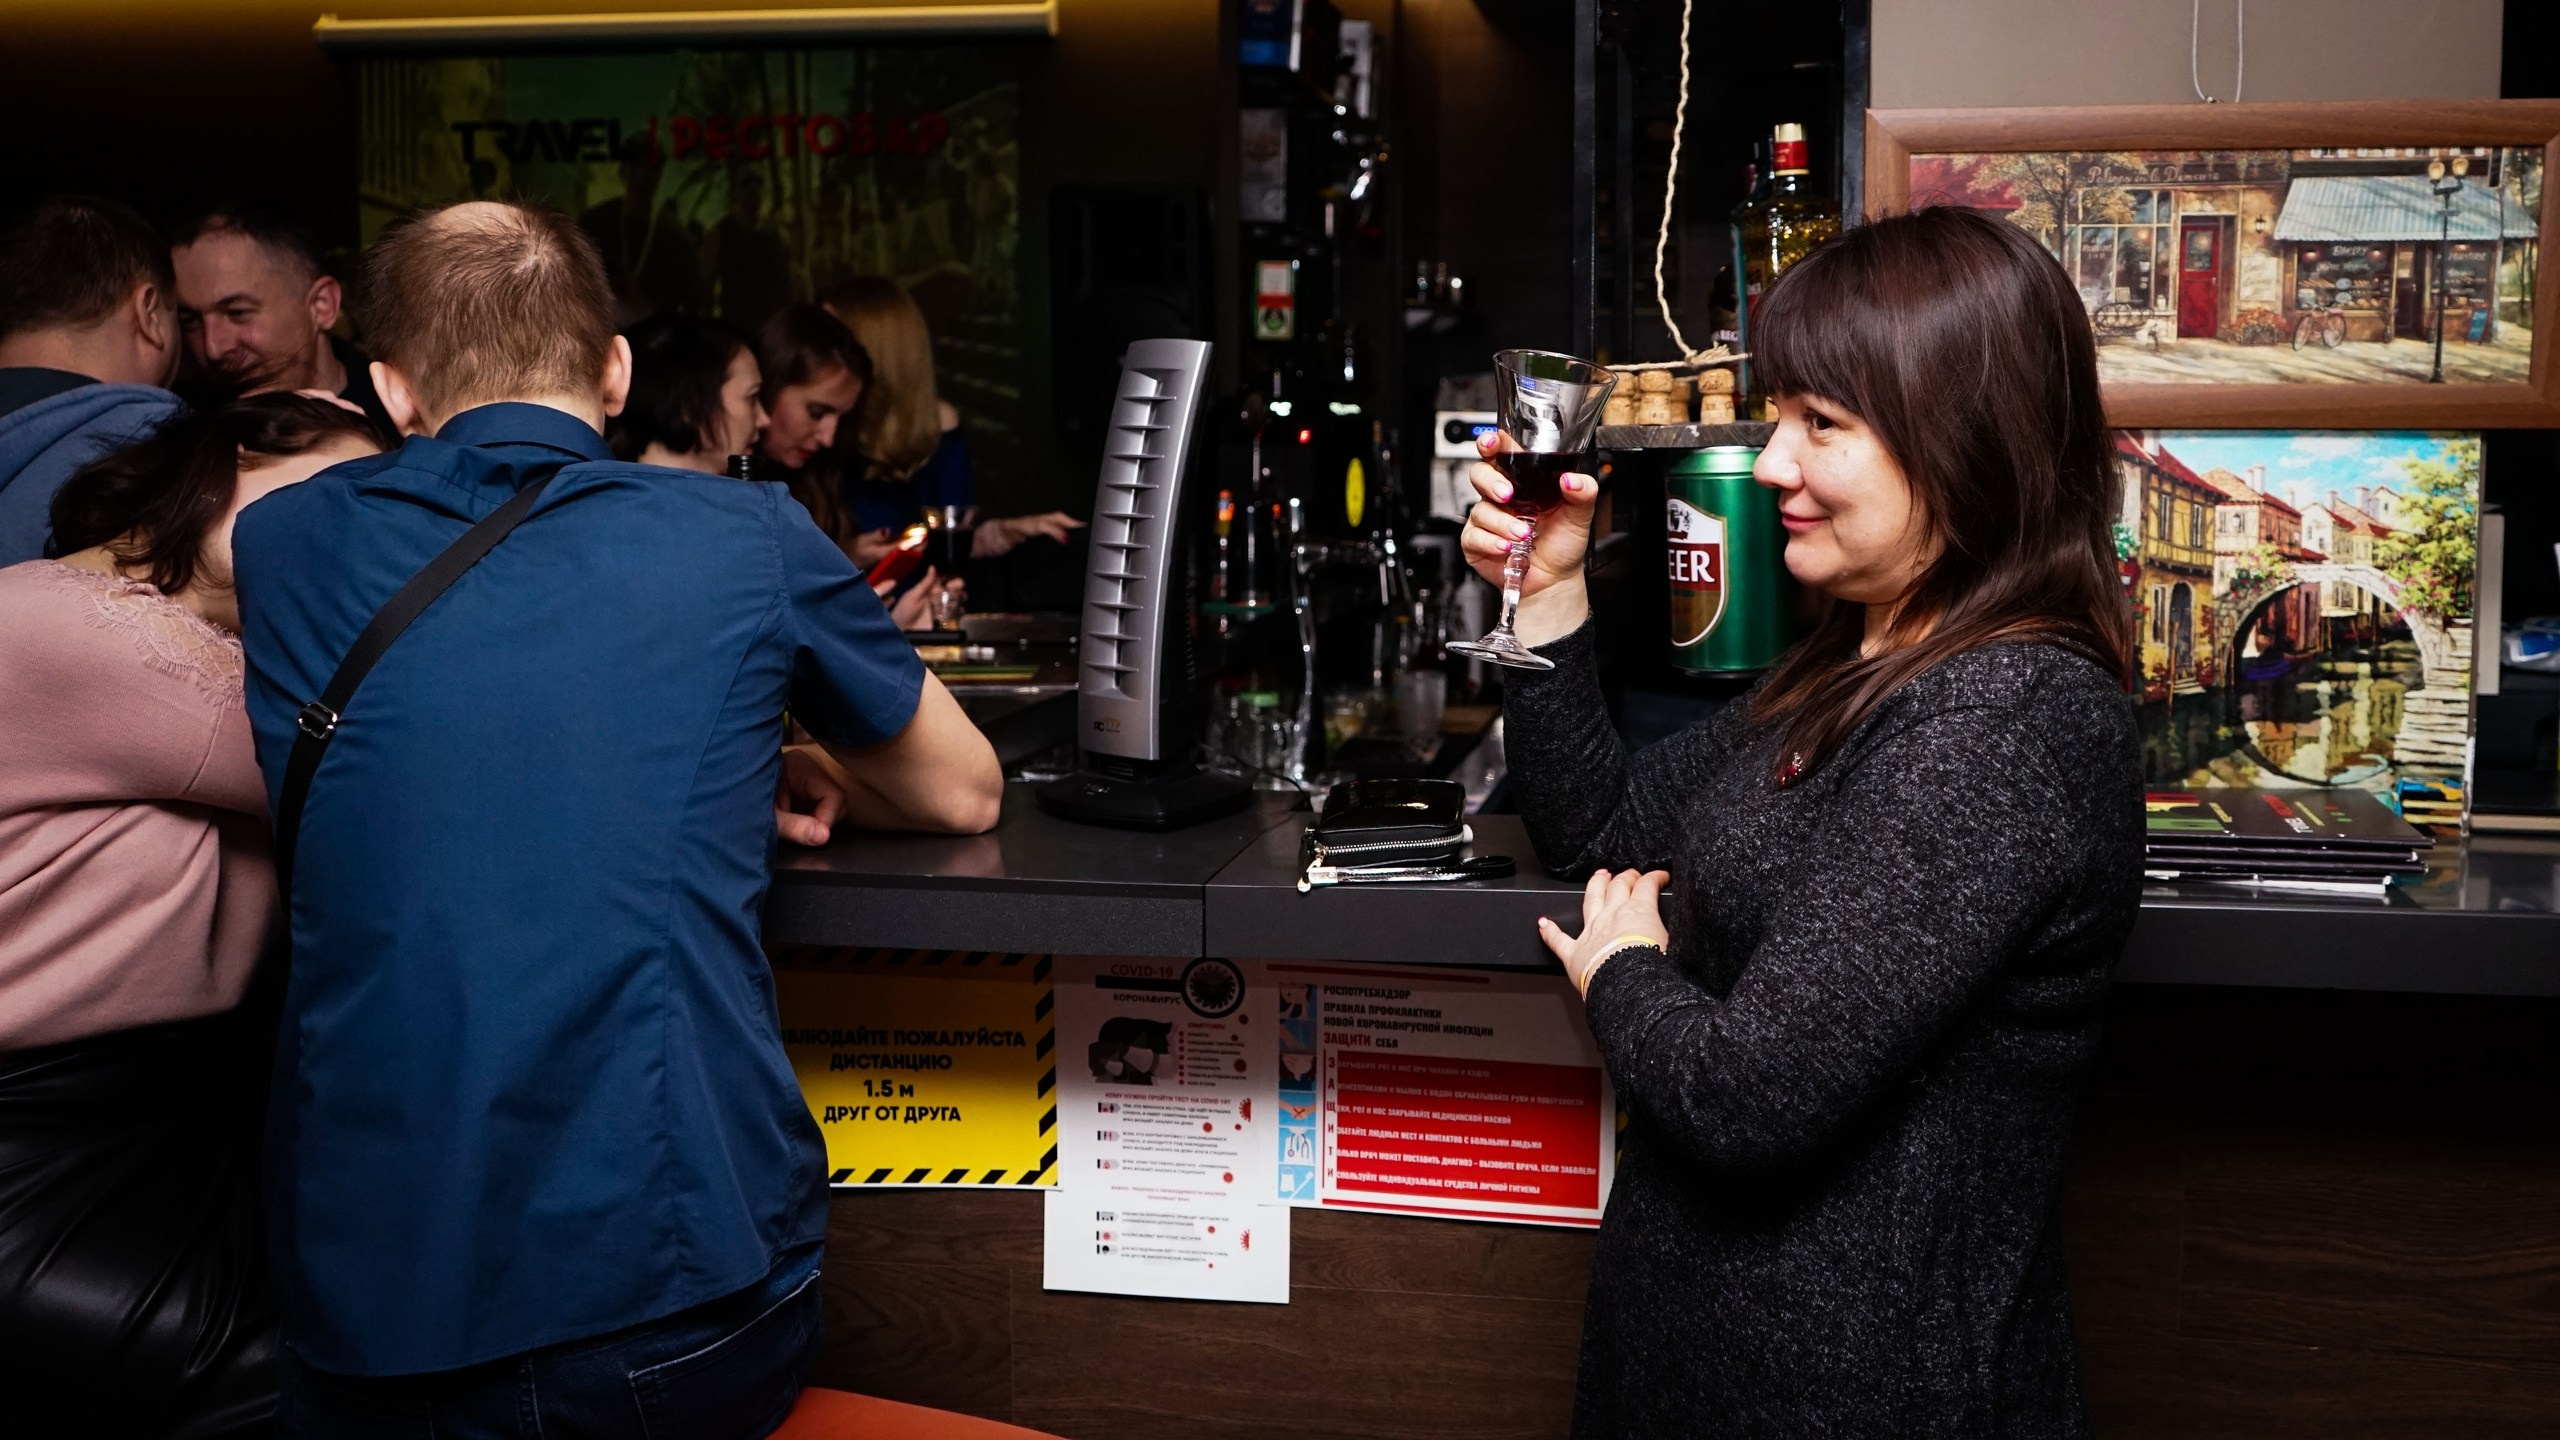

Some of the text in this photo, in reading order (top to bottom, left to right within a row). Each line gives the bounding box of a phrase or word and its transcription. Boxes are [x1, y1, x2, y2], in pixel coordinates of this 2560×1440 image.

[451, 120, 634, 164] TRAVEL
[672, 113, 951, 161] РЕСТОБАР
[1111, 964, 1173, 978] COVID-19
[1113, 994, 1181, 1005] КОРОНАВИРУС
[1324, 985, 1411, 1000] РОСПОТРЕБНАДЗОР
[1324, 1002, 1442, 1018] ПРАВИЛА ПРОФИЛАКТИКИ
[1324, 1016, 1494, 1037] НОВОЙ КОРОНАВИРУСНОЙ ИНФЕКЦИИ
[894, 1027, 1026, 1047] ПОЖАЛУЙСТА
[1324, 1032, 1398, 1048] ЗАЩИТИ СЕБЯ
[830, 1054, 952, 1071] ДИСТАНЦИЮ
[863, 1080, 893, 1098] 1.5
[1148, 1094, 1174, 1102] ПРОЙТИ
[824, 1105, 961, 1123] ДРУГ ОТ ДРУГА
[1388, 1108, 1431, 1119] ЗАКРЫВАЙТЕ
[1484, 1114, 1512, 1124] МАСКОЙ
[1368, 1129, 1400, 1139] ЛЮДНЫХ
[1401, 1131, 1417, 1140] МЕСТ
[1425, 1132, 1463, 1144] КОНТАКТОВ
[1470, 1136, 1509, 1147] БОЛЬНЫМИ
[1511, 1139, 1543, 1150] ЛЮДЬМИ
[1360, 1150, 1378, 1160] ВРАЧ
[1379, 1152, 1401, 1162] МОЖЕТ
[1403, 1153, 1440, 1165] ПОСТАВИТЬ
[1441, 1156, 1473, 1168] ДИАГНОЗ
[1479, 1159, 1515, 1170] ВЫЗОВИТЕ
[1541, 1164, 1560, 1173] ЕСЛИ
[1561, 1165, 1597, 1176] ЗАБОЛЕЛИ
[1379, 1173, 1442, 1187] ИНДИВИДУАЛЬНЫЕ
[1444, 1178, 1479, 1190] СРЕДСТВА
[1480, 1181, 1508, 1192] ЛИЧНОЙ
[1509, 1185, 1541, 1195] ГИГИЕНЫ
